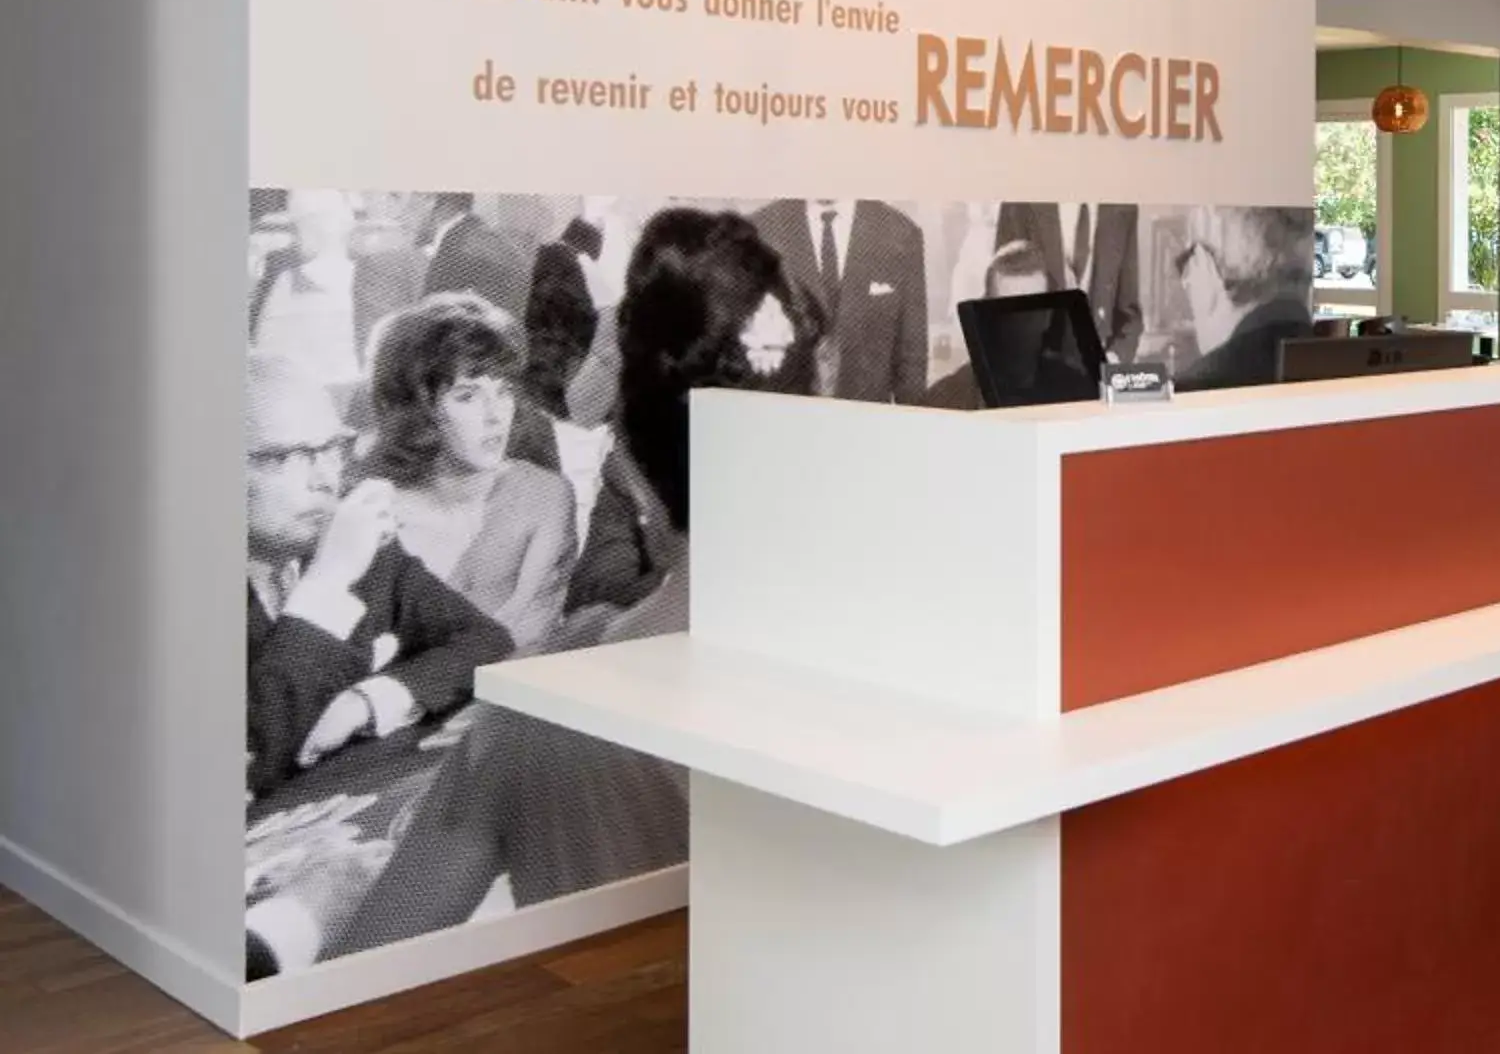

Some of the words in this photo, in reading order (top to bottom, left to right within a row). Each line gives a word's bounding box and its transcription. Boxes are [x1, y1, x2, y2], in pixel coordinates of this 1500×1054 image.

[473, 59, 515, 102] de
[537, 74, 650, 109] revenir
[669, 81, 697, 112] et
[714, 83, 826, 125] toujours
[842, 98, 898, 123] vous
[916, 34, 1223, 142] REMERCIER
